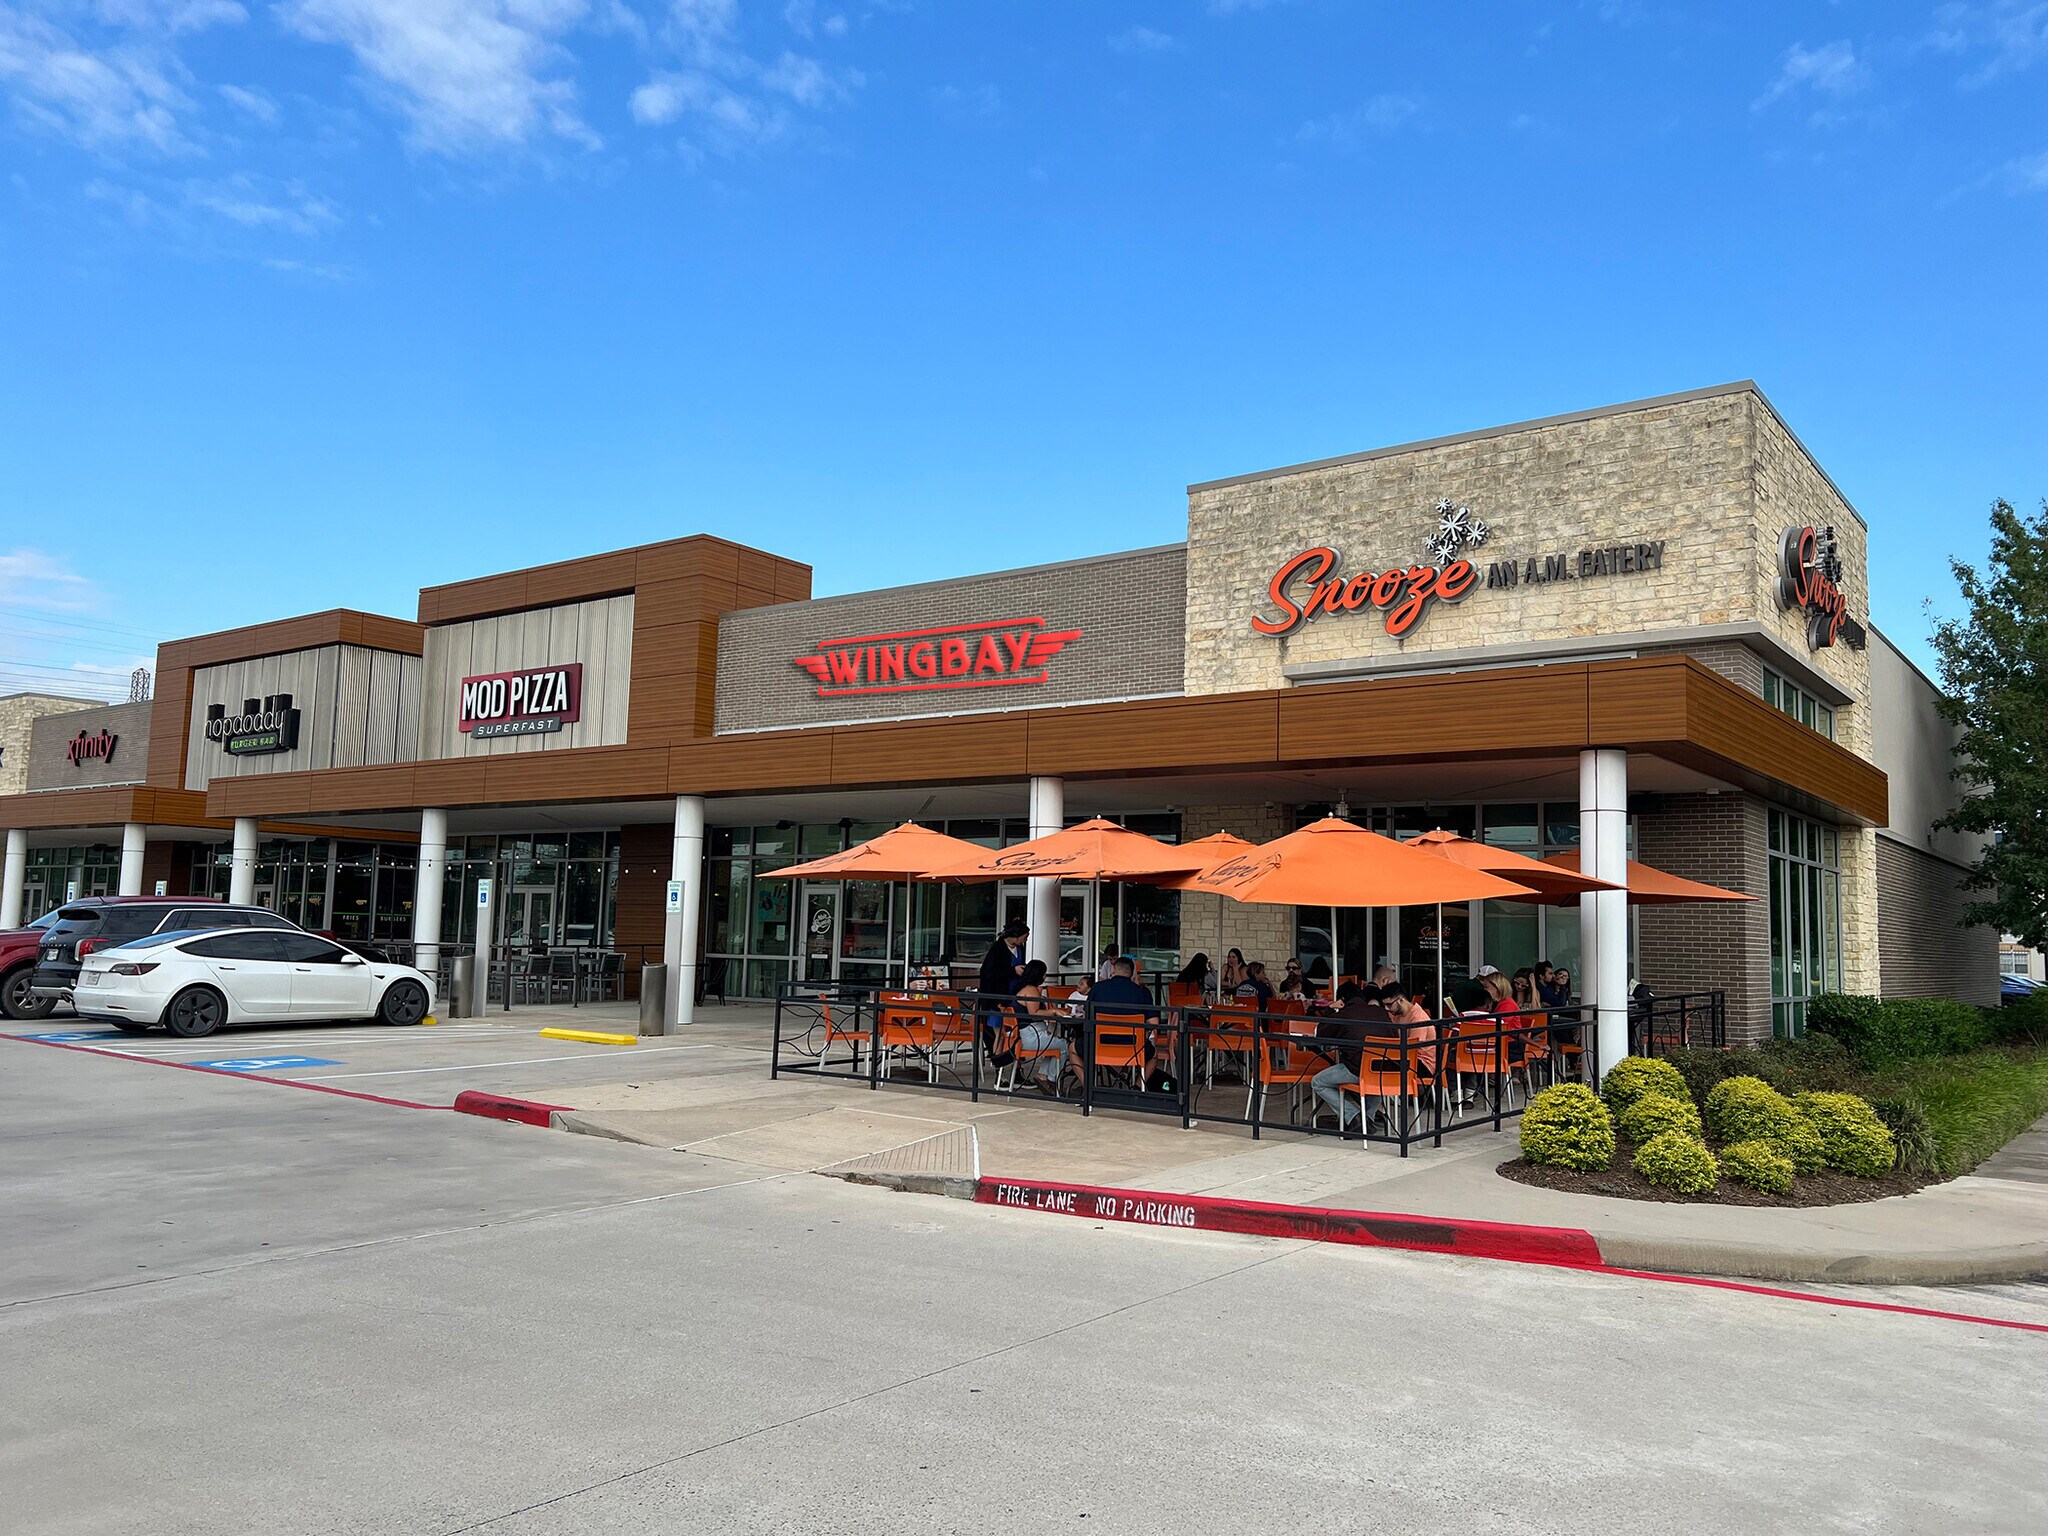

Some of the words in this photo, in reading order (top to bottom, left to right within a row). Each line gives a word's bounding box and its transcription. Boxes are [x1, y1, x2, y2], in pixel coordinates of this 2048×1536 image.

[1251, 546, 1480, 637] Snooze
[1487, 560, 1518, 589] AN
[1524, 553, 1572, 585] A.M.
[1578, 540, 1666, 578] EATERY
[827, 631, 1032, 684] WINGBAY
[461, 679, 507, 721] MOD
[509, 671, 568, 716] PIZZA
[66, 728, 115, 766] xfinity
[477, 719, 554, 735] SUPERFAST
[996, 1183, 1030, 1207] FIRE
[1036, 1190, 1077, 1213] LANE
[1095, 1196, 1116, 1217] NO
[1122, 1199, 1196, 1227] PARKING
